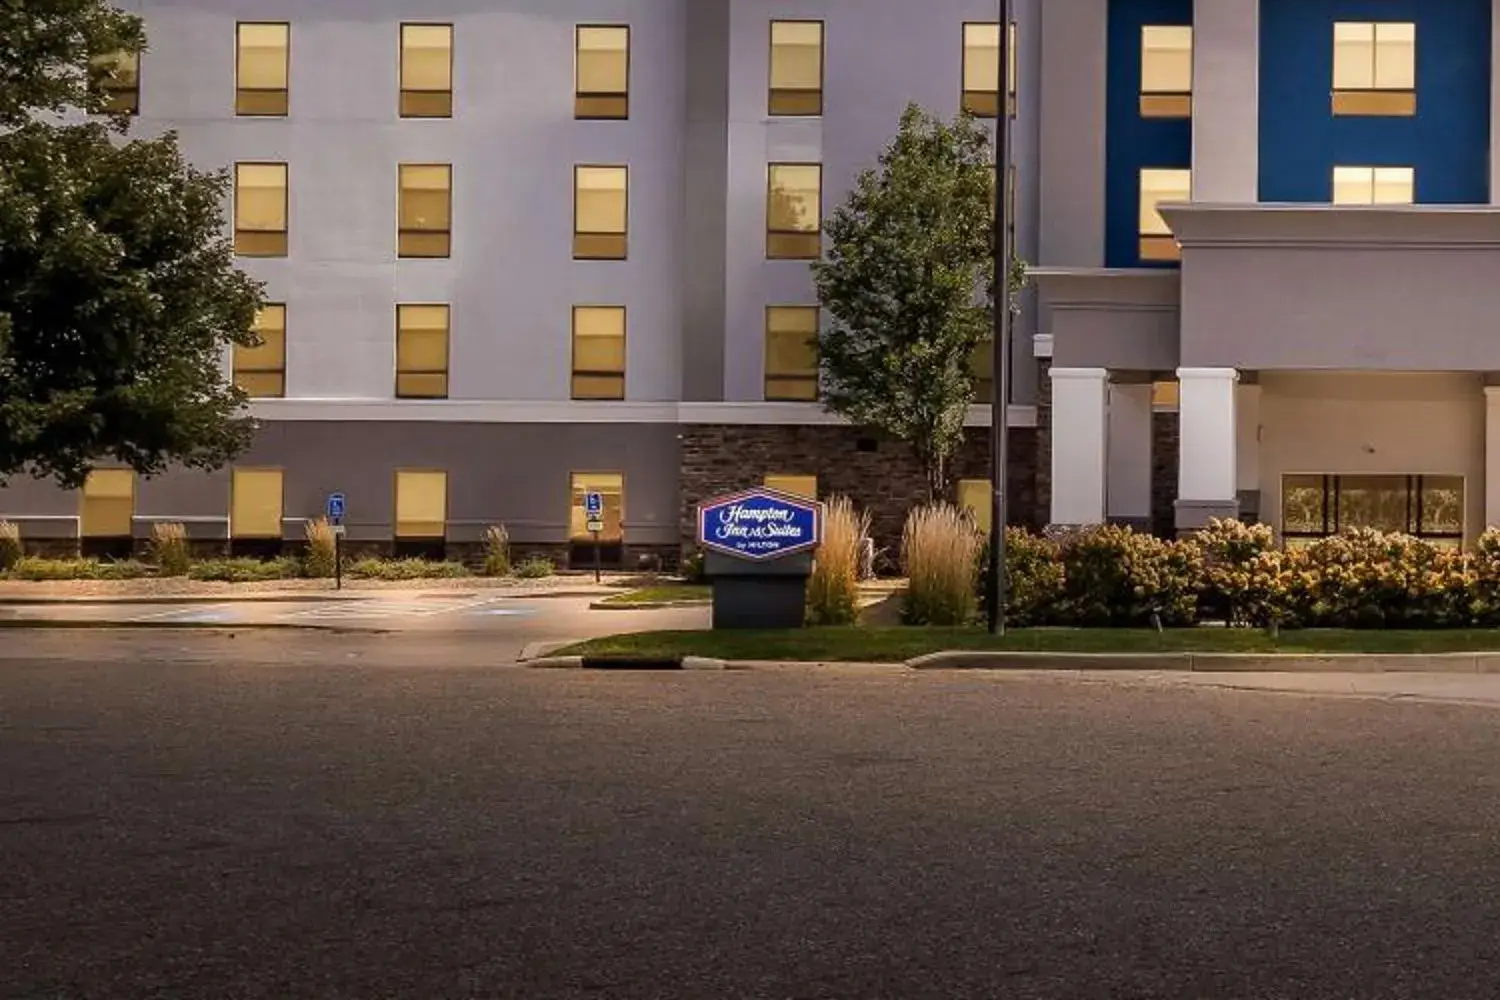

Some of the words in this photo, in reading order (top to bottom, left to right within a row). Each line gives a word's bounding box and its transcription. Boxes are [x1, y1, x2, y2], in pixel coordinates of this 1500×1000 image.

[719, 505, 794, 523] Hampton
[715, 523, 753, 538] Inn
[761, 522, 801, 537] Suites
